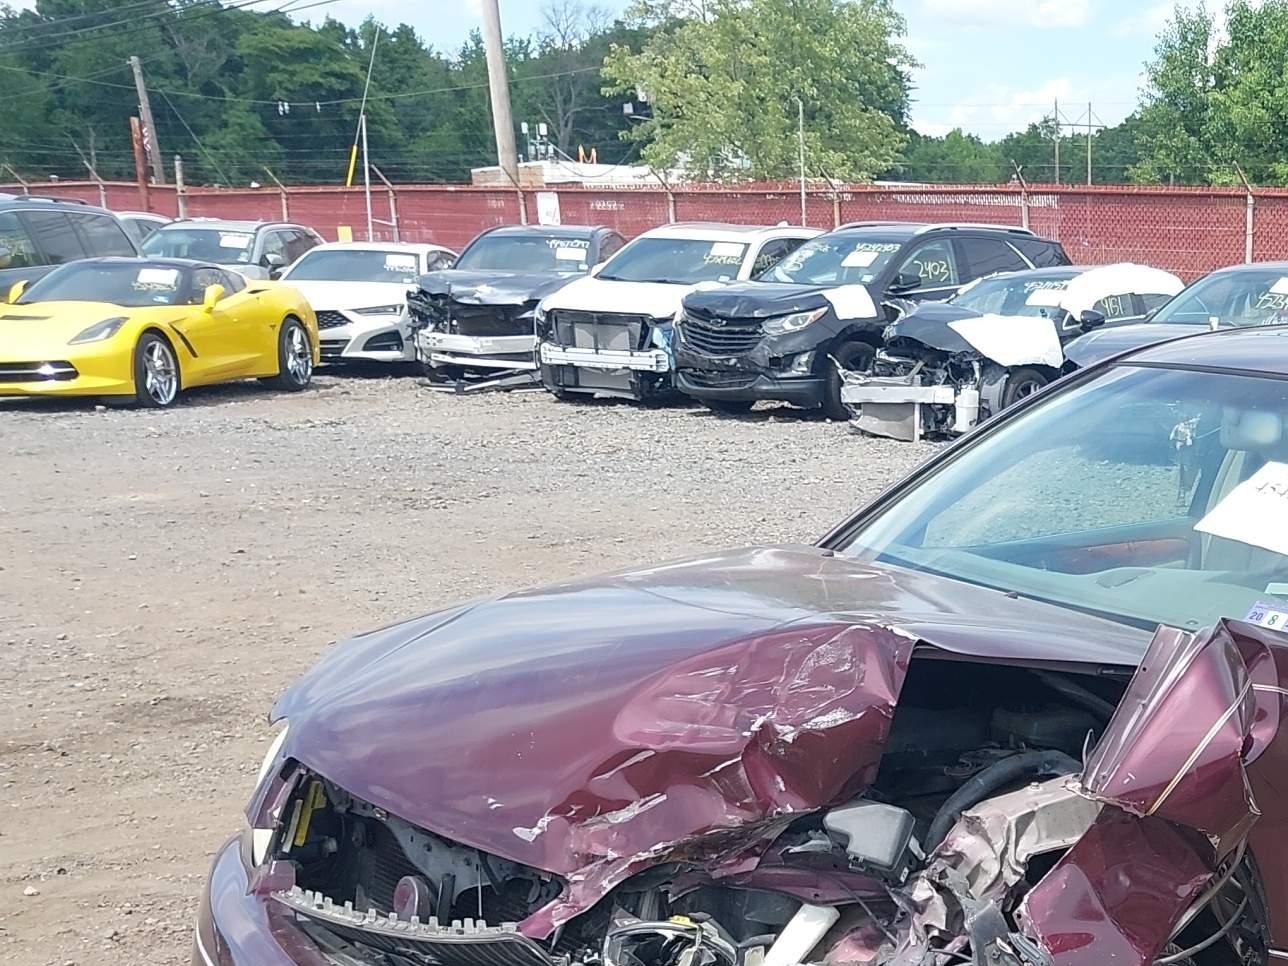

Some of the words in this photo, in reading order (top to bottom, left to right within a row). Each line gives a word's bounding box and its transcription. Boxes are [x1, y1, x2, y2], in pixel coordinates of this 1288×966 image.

[914, 260, 949, 282] 2403
[1248, 611, 1264, 621] 20
[1267, 614, 1279, 626] 8
